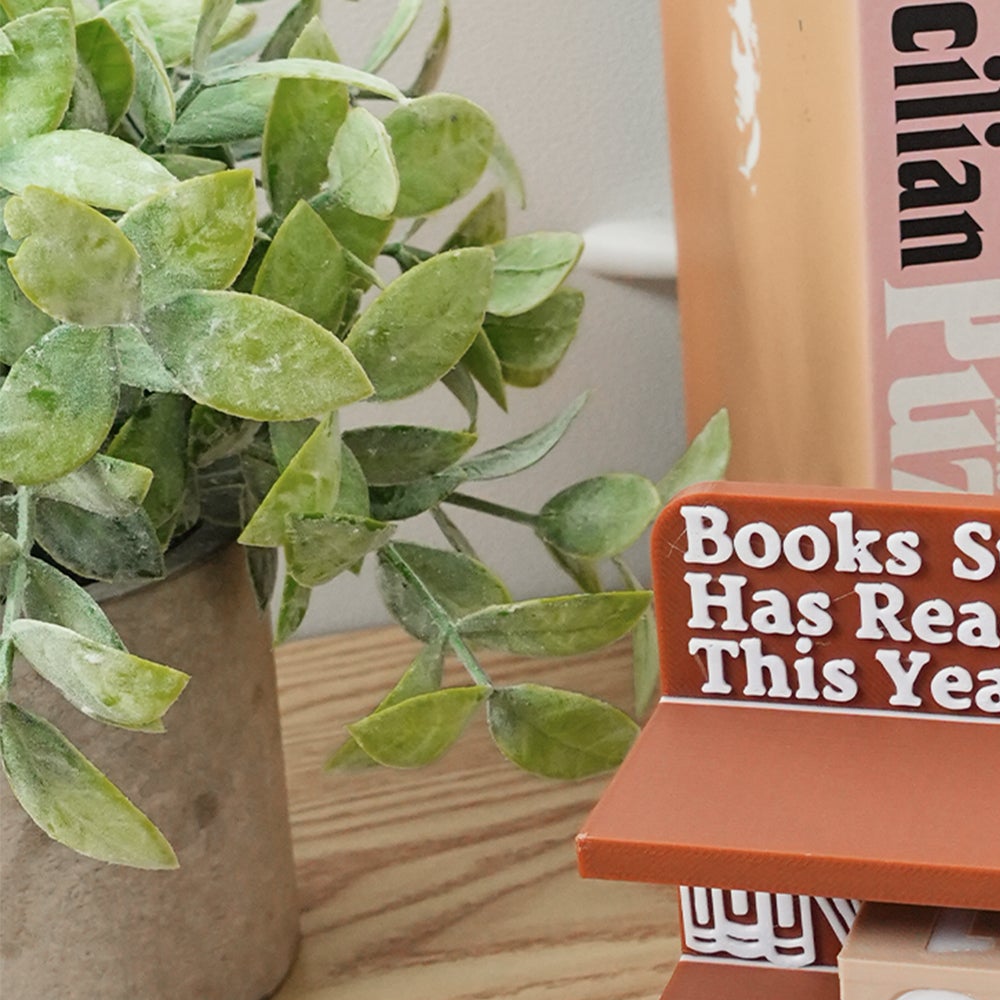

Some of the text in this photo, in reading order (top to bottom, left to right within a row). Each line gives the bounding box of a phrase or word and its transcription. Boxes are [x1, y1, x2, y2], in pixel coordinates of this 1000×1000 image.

[679, 504, 922, 577] Books
[683, 571, 834, 638] Has
[687, 636, 860, 702] This
